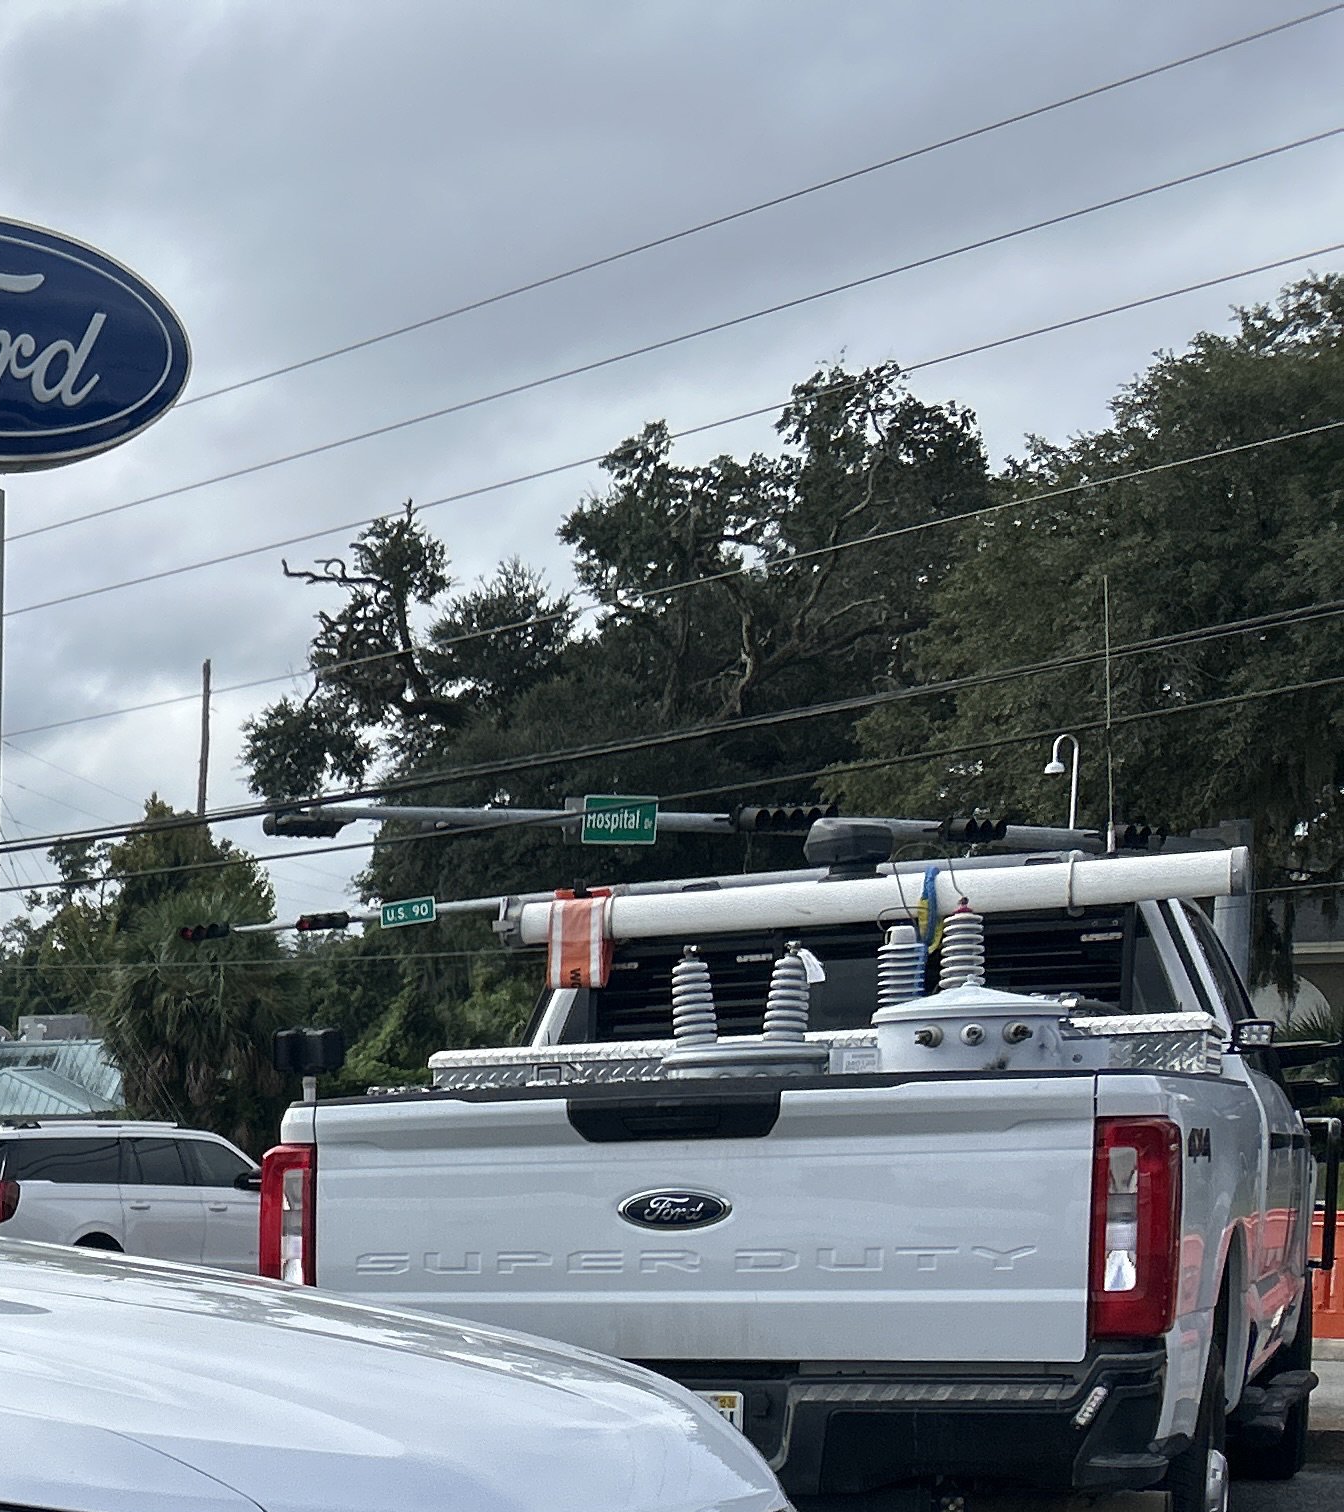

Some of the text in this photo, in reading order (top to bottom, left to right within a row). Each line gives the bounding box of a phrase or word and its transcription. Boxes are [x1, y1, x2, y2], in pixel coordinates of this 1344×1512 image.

[586, 809, 641, 834] Hospital
[386, 903, 429, 922] U.S. 90
[643, 1196, 704, 1221] Ford
[355, 1245, 1038, 1275] SUPER DUTY
